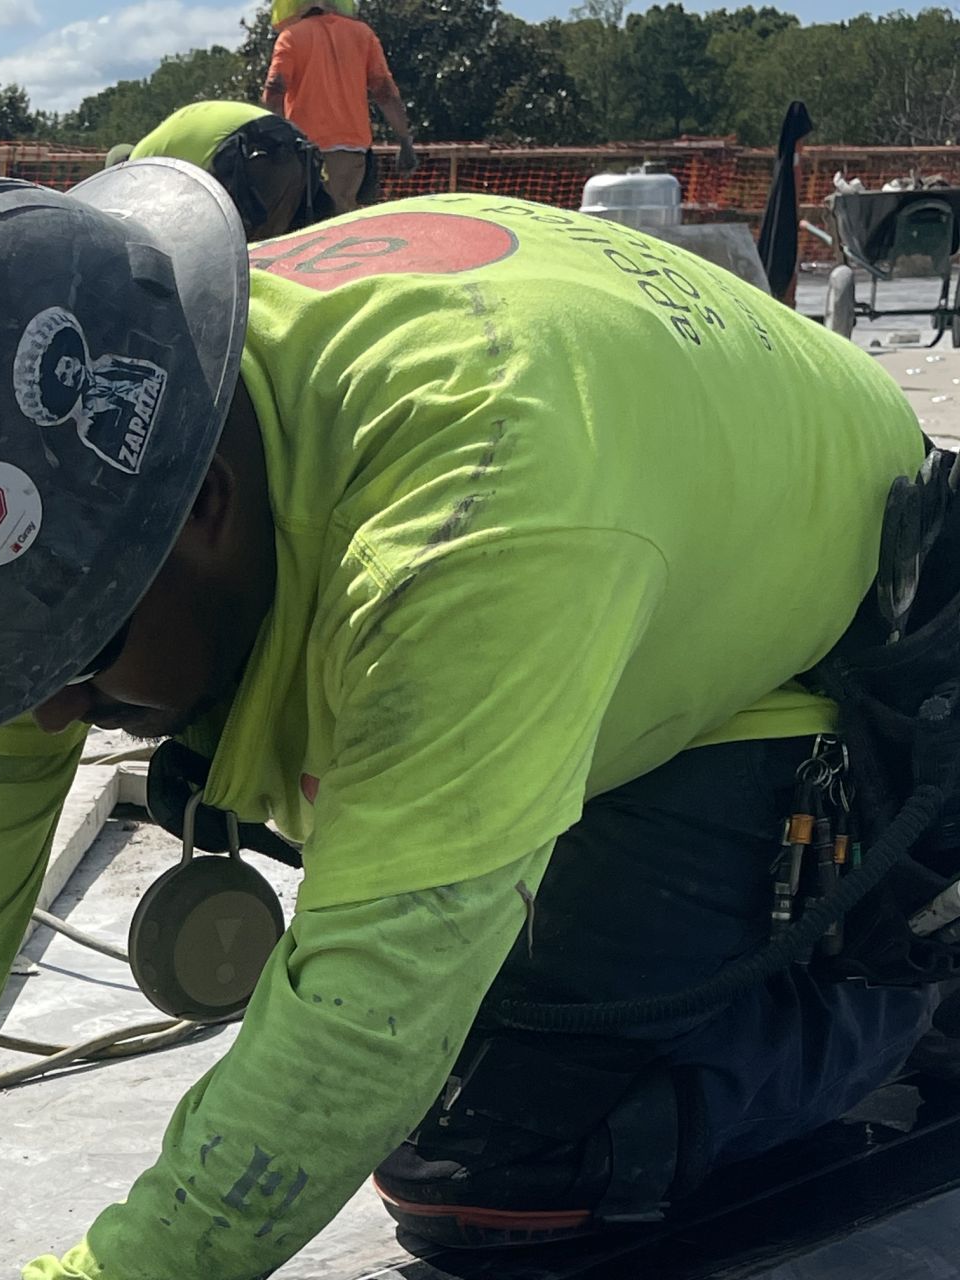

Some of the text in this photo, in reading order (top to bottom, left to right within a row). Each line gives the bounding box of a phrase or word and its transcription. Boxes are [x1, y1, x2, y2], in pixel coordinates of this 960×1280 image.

[479, 204, 701, 347] applied
[118, 377, 161, 468] ZAPATA
[17, 520, 37, 543] Gray
